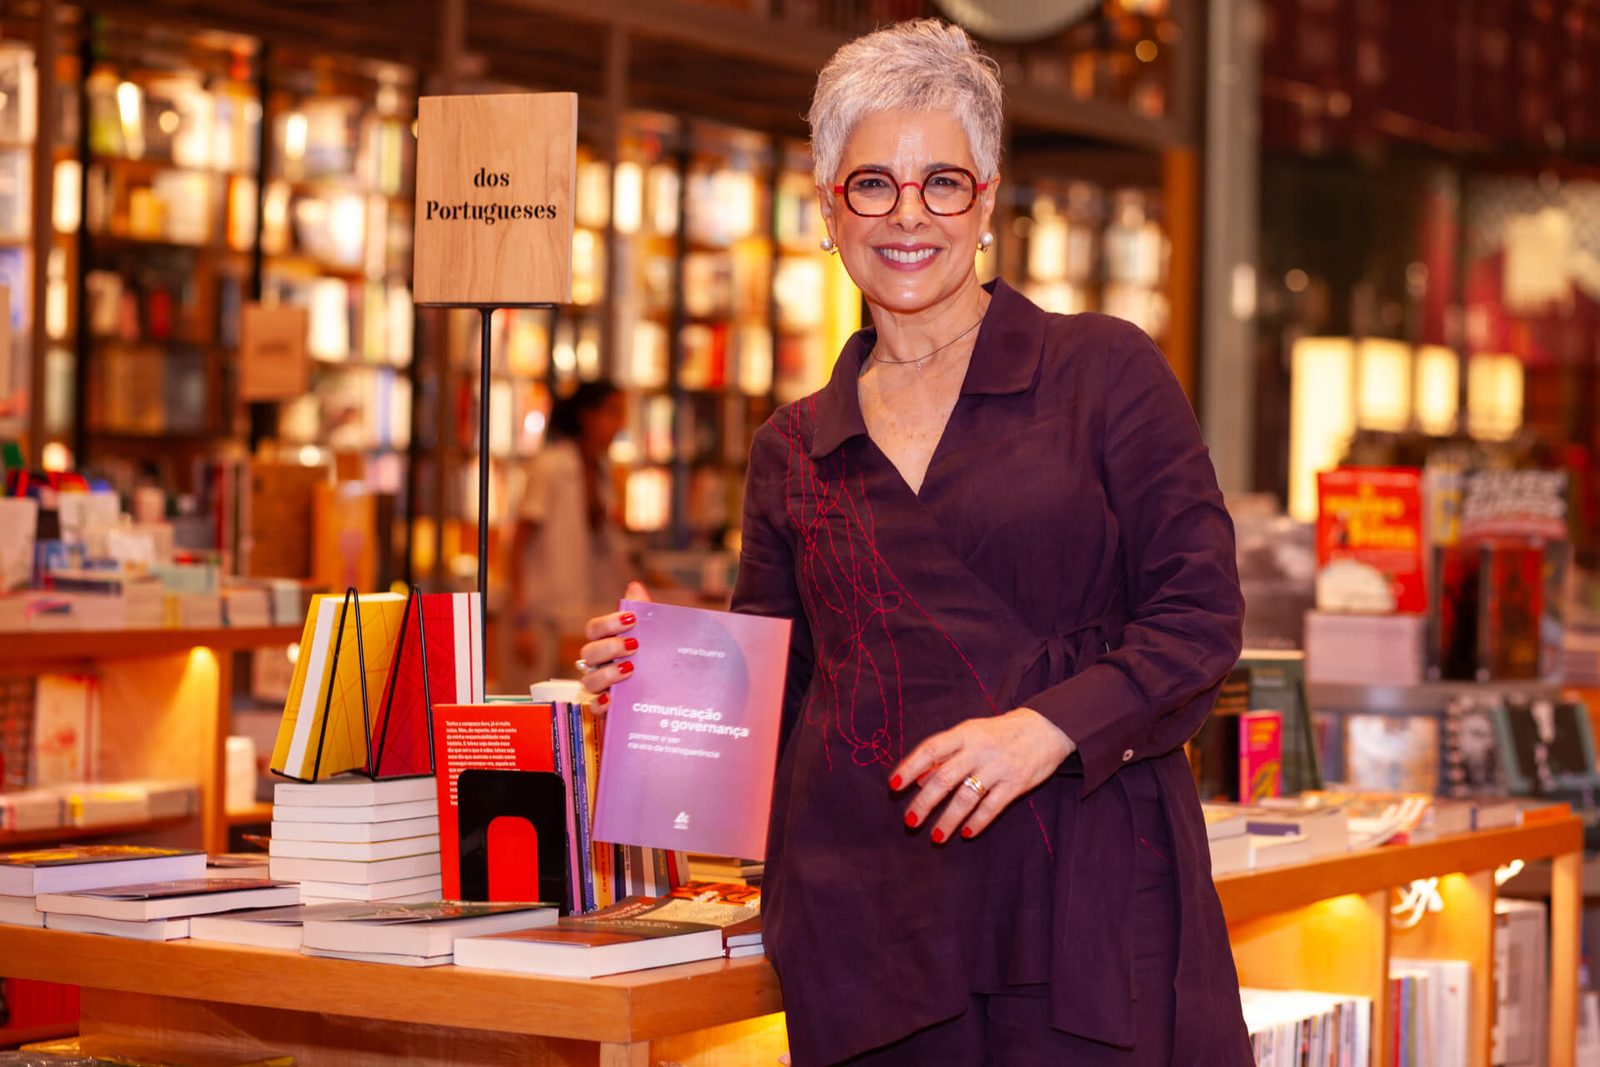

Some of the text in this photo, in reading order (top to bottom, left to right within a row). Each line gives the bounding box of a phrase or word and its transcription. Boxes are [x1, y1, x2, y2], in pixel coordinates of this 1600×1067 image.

[473, 167, 510, 188] dos
[426, 200, 557, 226] Portugueses
[698, 648, 726, 659] bueno
[631, 702, 723, 722] comunicação
[628, 731, 660, 741] parecer
[667, 736, 681, 744] ser
[659, 719, 750, 740] e governança
[627, 741, 638, 750] na
[639, 742, 652, 751] era
[664, 744, 721, 760] transparência
